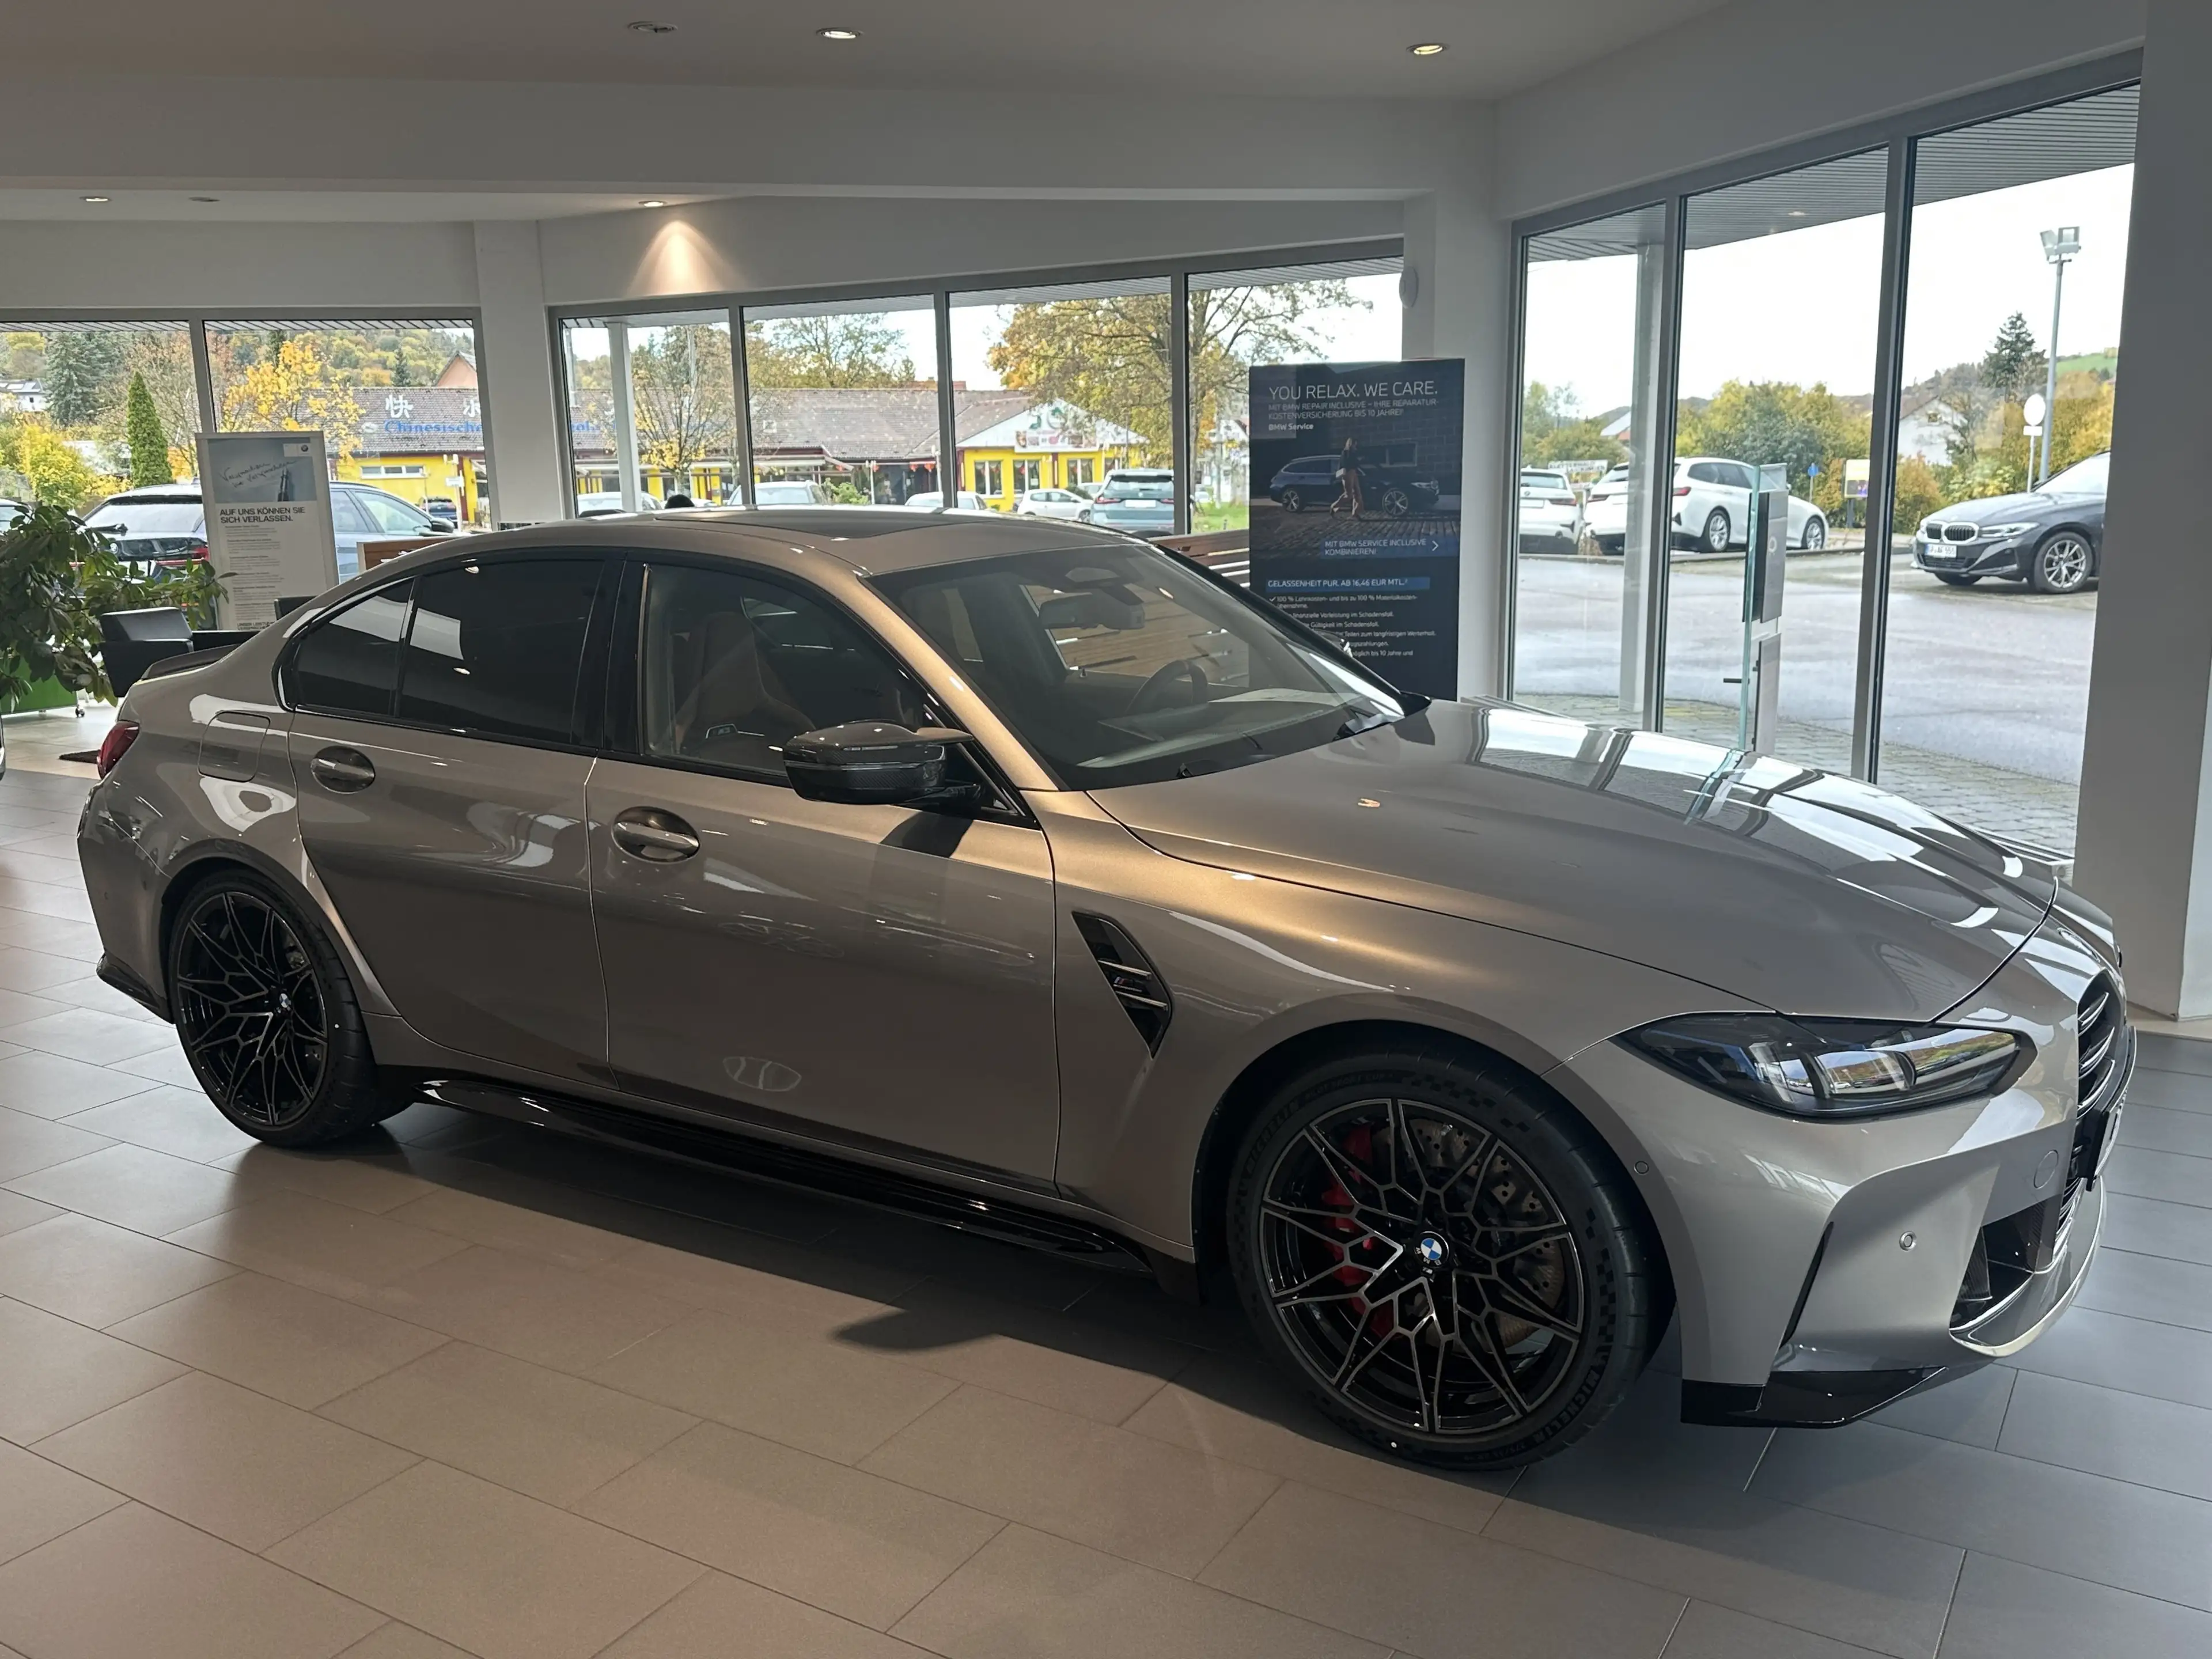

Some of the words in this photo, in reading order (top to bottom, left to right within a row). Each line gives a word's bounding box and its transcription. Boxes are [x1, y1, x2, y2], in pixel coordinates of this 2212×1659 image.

[1269, 386, 1301, 400] YOU
[1306, 384, 1359, 399] RELAX.
[1364, 382, 1388, 396] WE
[1393, 381, 1438, 396] CARE.
[1329, 401, 1366, 409] INCLUSIVE
[1392, 399, 1439, 407] REPARATUR-
[1268, 410, 1353, 420] KOSTENVERSICHERUNG
[1354, 409, 1366, 417] BIS
[257, 506, 291, 515] KÖNNEN
[241, 515, 293, 523] VERLASSEN.
[1267, 579, 1321, 588] GELASSENHEIT
[1353, 579, 1370, 587] 16,46
[1532, 1369, 1601, 1444] MICHELIN
